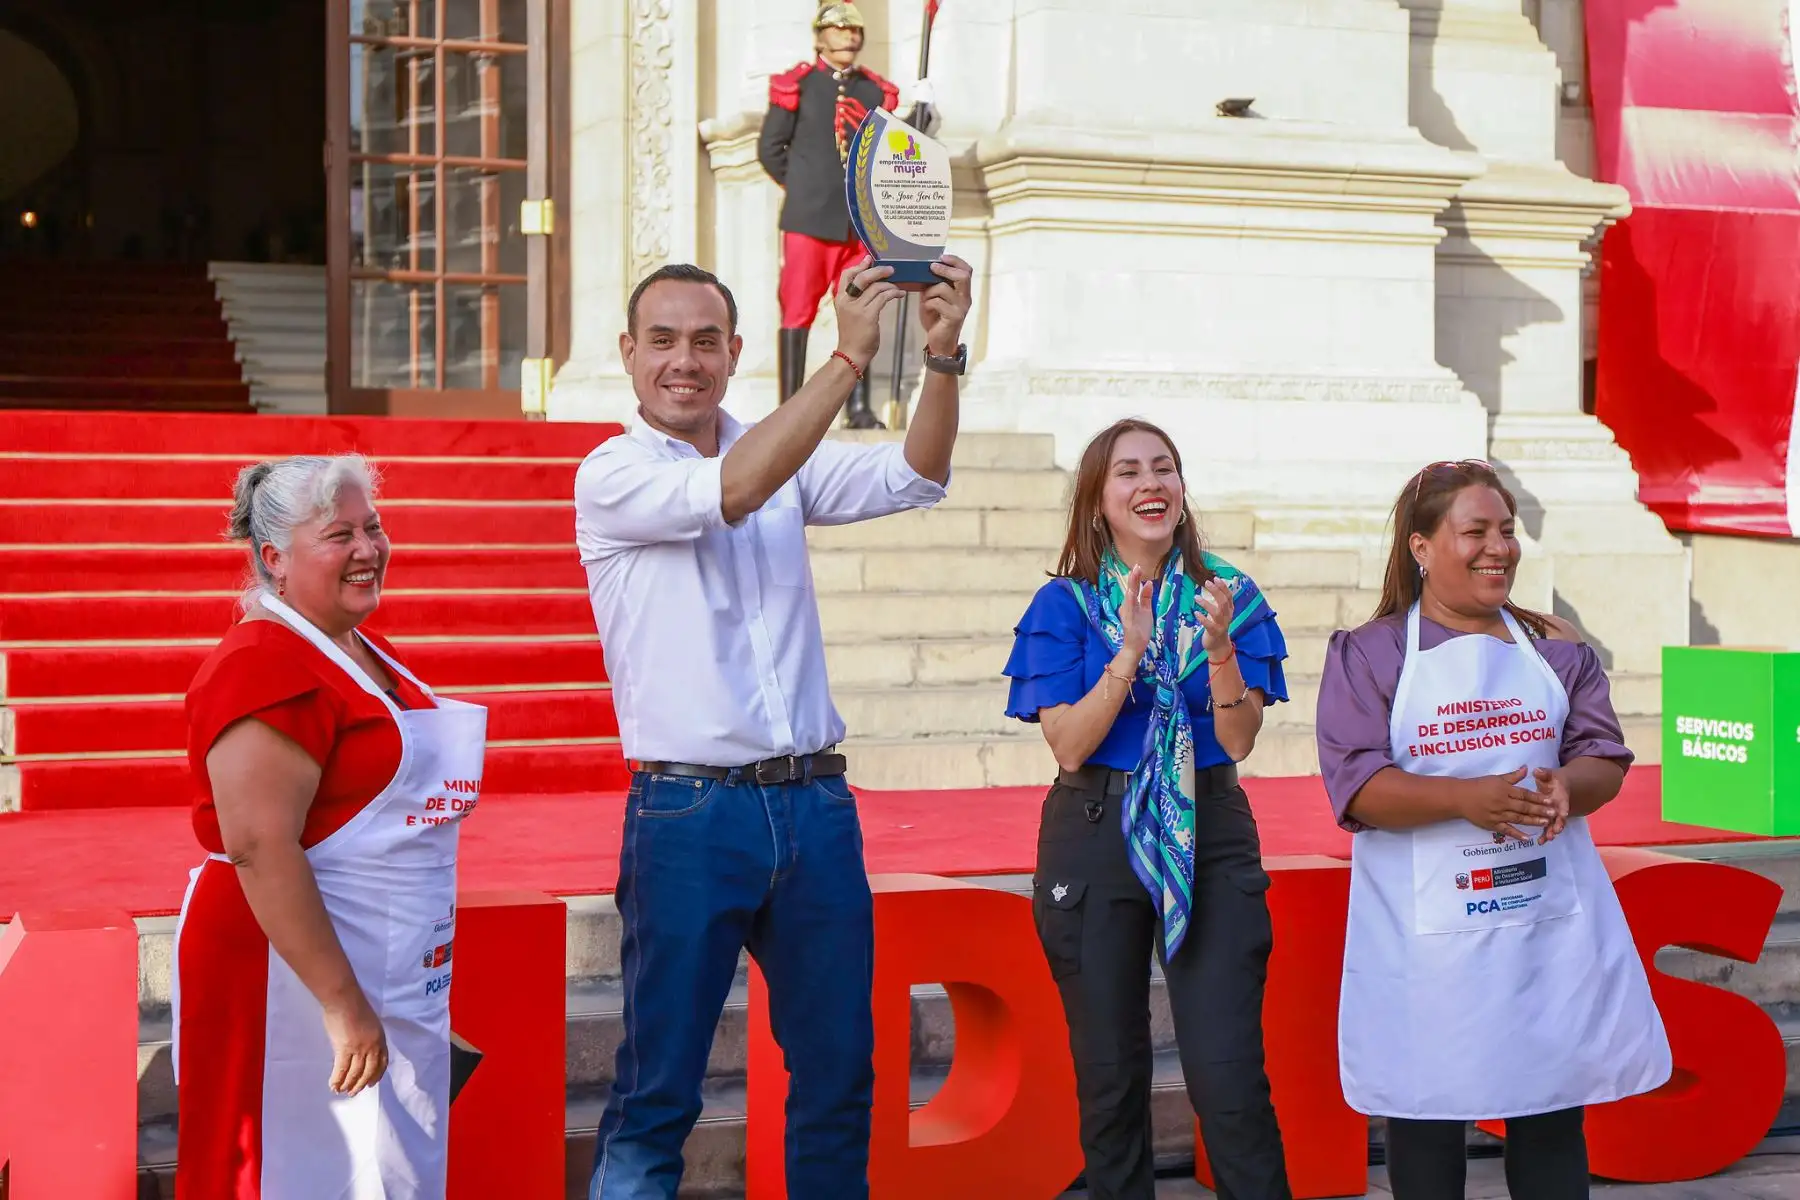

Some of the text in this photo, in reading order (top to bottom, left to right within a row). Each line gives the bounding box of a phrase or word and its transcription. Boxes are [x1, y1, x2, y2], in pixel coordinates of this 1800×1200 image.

[894, 165, 927, 178] mujer
[1438, 698, 1522, 716] MINISTERIO
[1418, 710, 1546, 737] DE DESARROLLO
[1676, 716, 1754, 741] SERVICIOS
[1409, 727, 1556, 757] E INCLUSIÓN SOCIAL
[1682, 736, 1748, 764] BÁSICOS
[425, 798, 446, 810] DE
[406, 816, 416, 826] E
[1463, 839, 1534, 857] Gobierno del Perú
[1466, 900, 1501, 916] PCA
